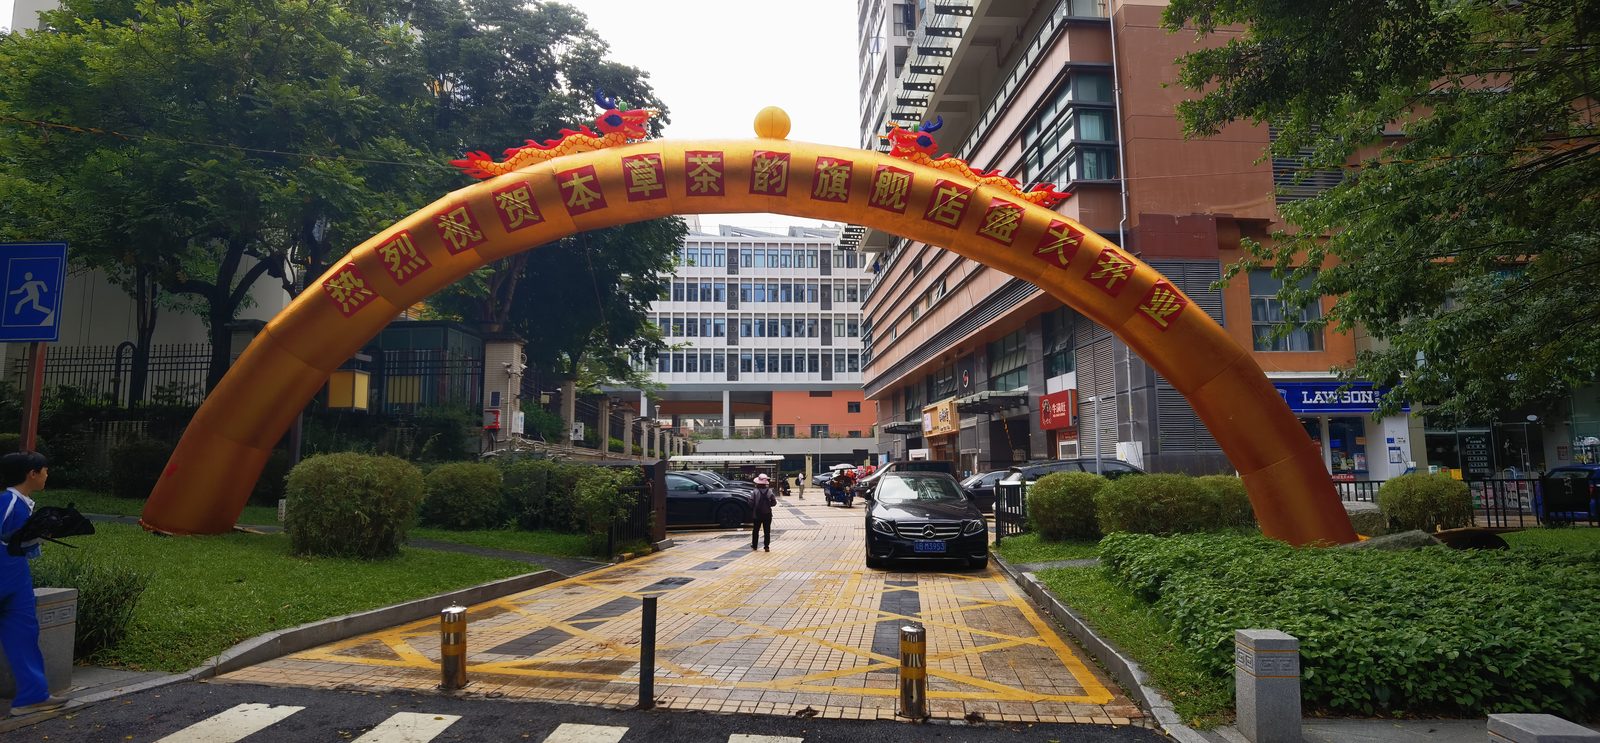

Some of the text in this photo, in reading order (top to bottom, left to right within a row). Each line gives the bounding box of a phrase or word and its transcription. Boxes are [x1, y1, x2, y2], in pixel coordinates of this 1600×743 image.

[325, 150, 1183, 329] 热烈祝贺本草茶韵旗舰店盛大开业
[1301, 390, 1374, 404] LAWSON
